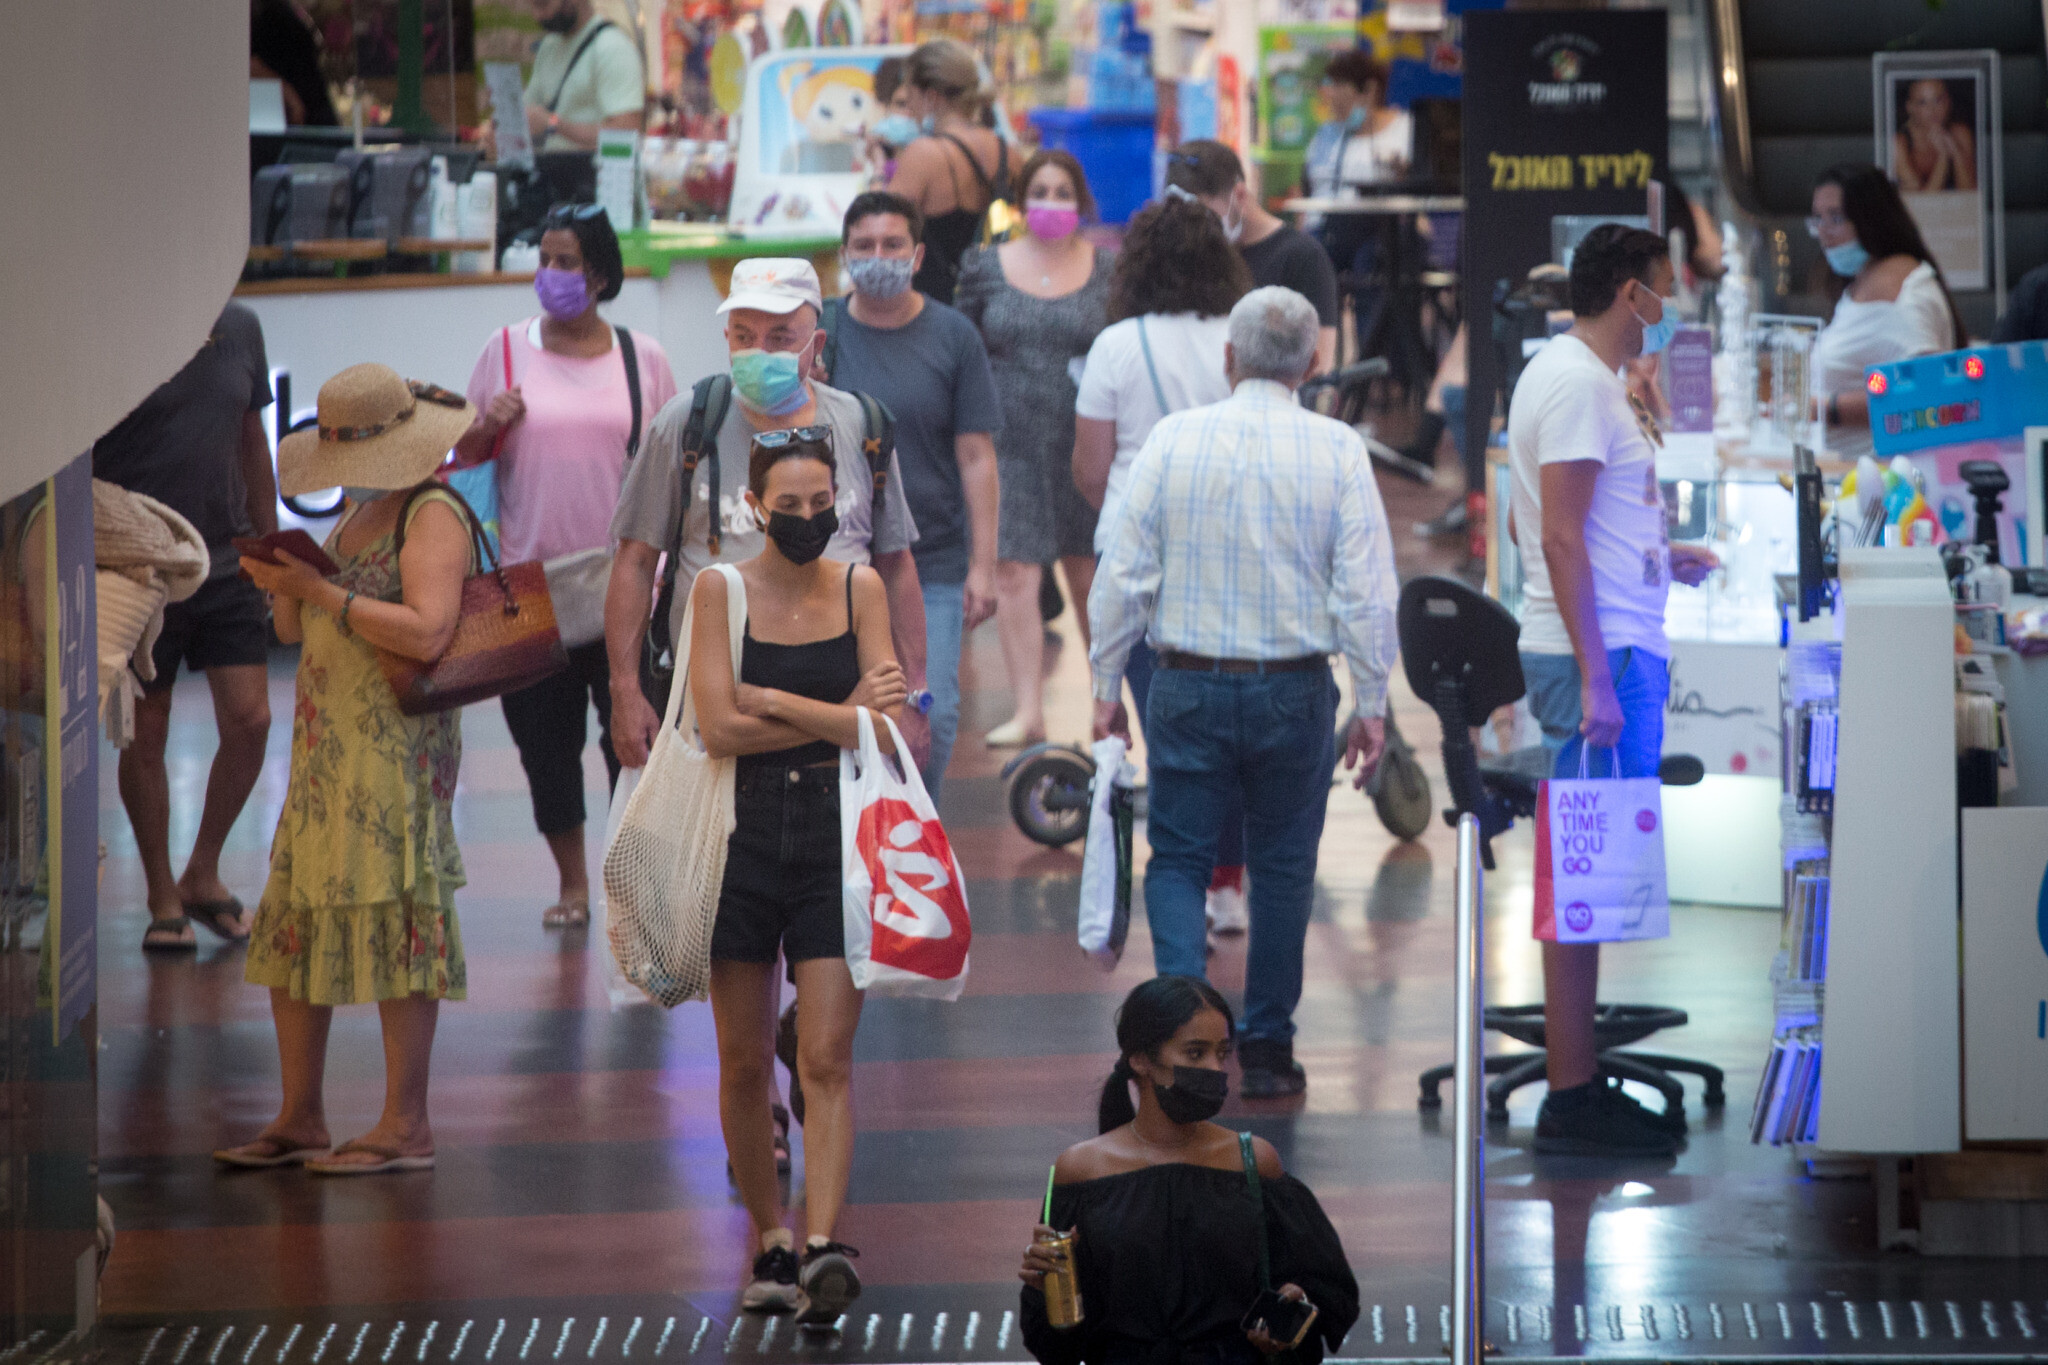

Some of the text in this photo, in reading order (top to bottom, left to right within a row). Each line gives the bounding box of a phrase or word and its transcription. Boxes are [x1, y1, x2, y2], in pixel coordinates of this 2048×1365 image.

[1488, 150, 1653, 190] ליריד האוכל
[1884, 400, 1981, 434] UNICORN
[1558, 790, 1600, 810] ANY
[1558, 812, 1608, 833] TIME
[1560, 834, 1604, 854] YOU
[1562, 856, 1592, 875] GO
